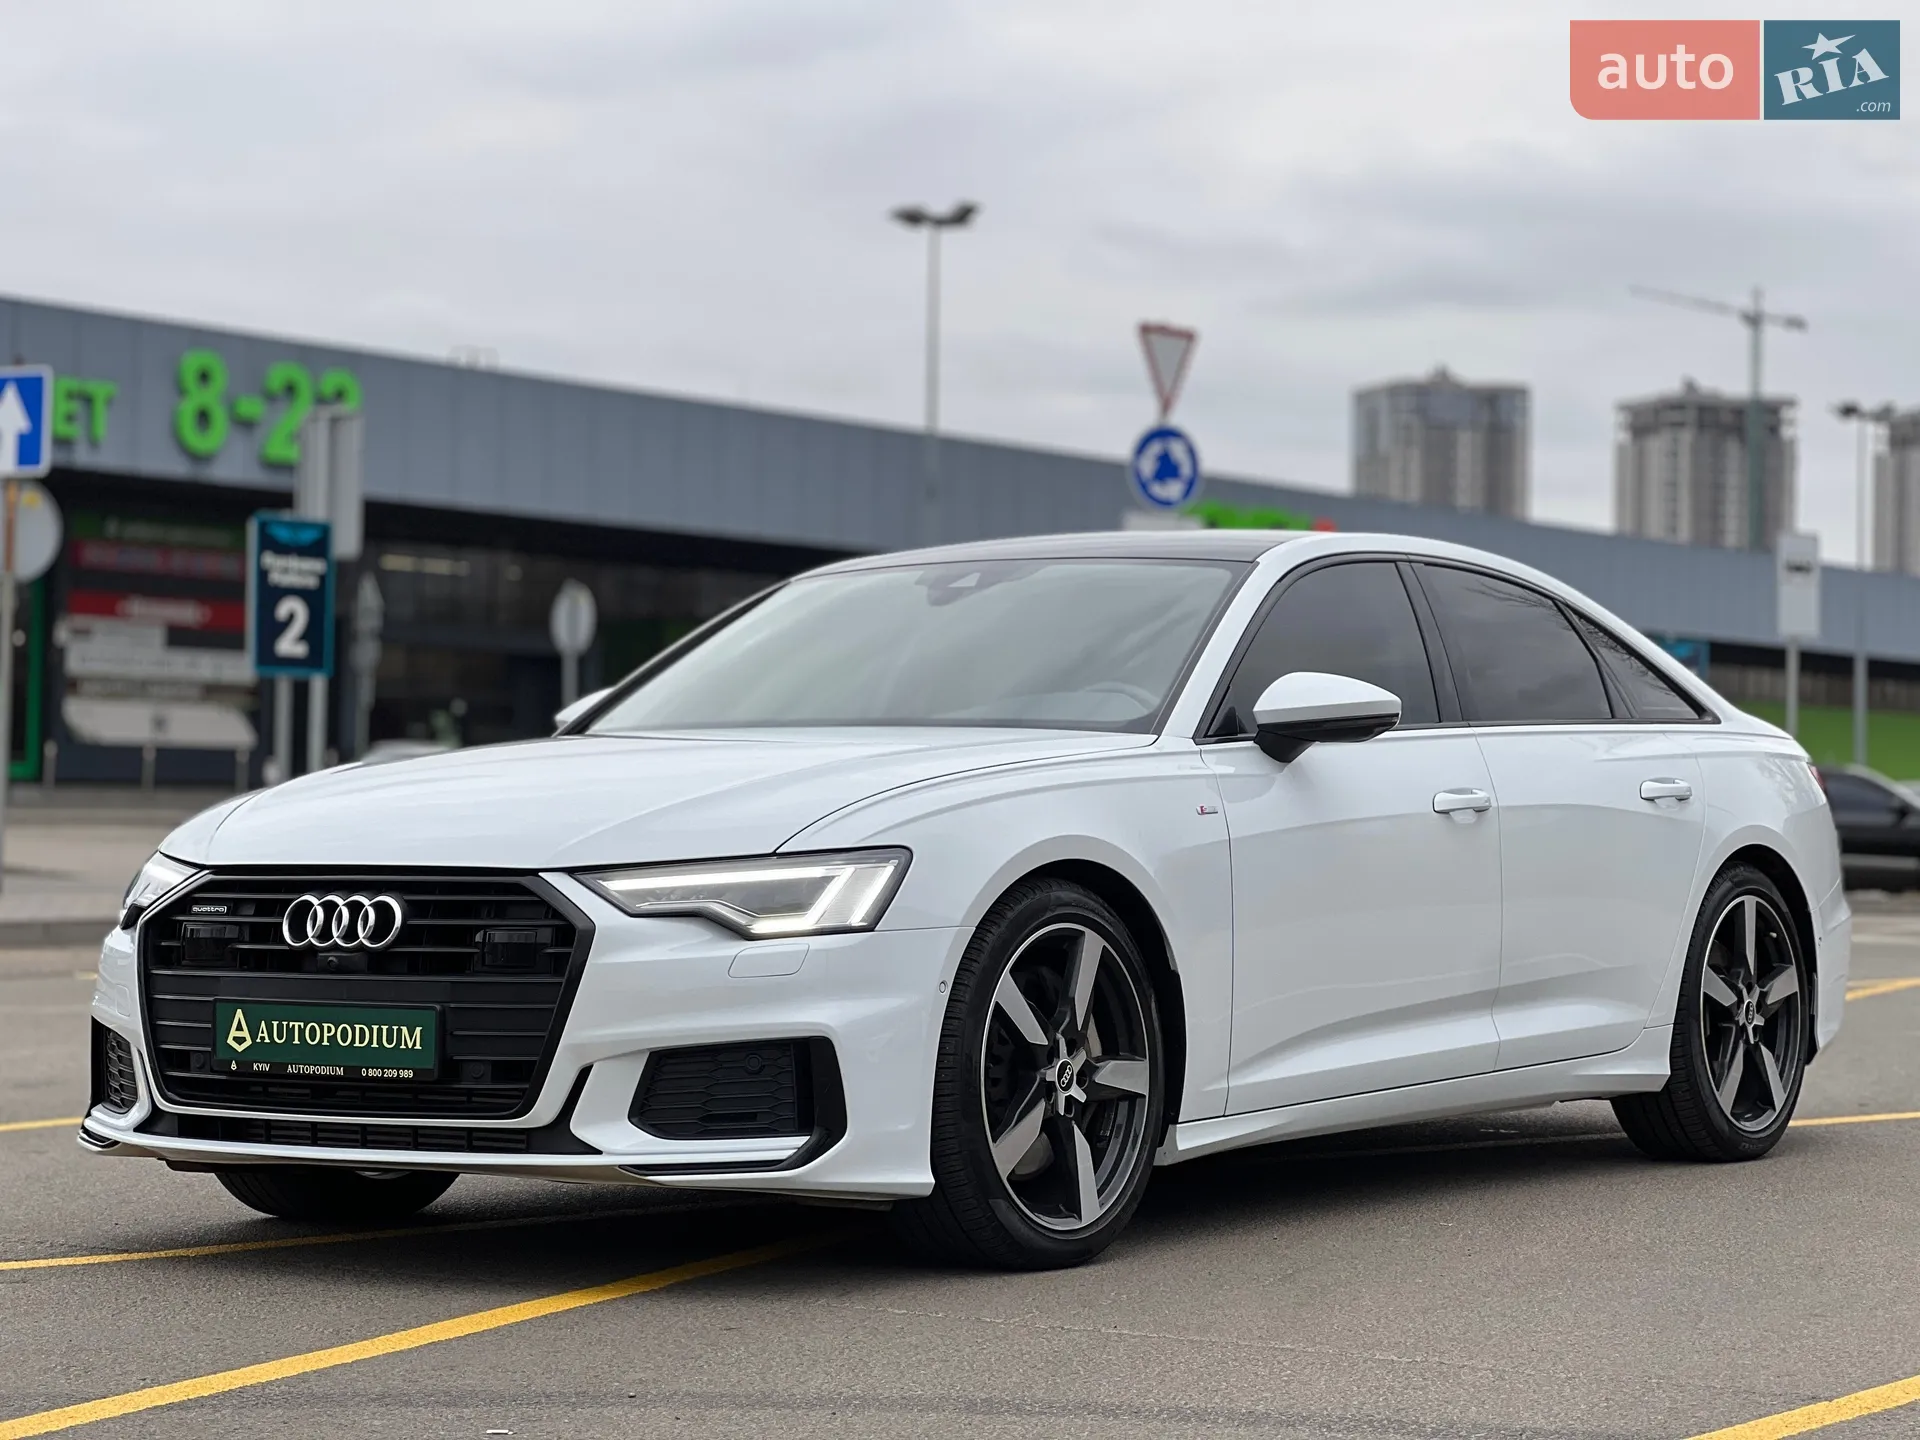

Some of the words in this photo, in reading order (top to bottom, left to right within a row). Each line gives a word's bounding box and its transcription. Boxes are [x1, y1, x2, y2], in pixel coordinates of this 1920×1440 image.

[274, 594, 310, 659] 2
[256, 1020, 423, 1050] AUTOPODIUM
[253, 1062, 270, 1072] KYIV
[286, 1064, 344, 1076] AUTOPODIUM
[367, 1068, 382, 1077] 800
[383, 1068, 397, 1077] 209
[398, 1069, 413, 1078] 989
